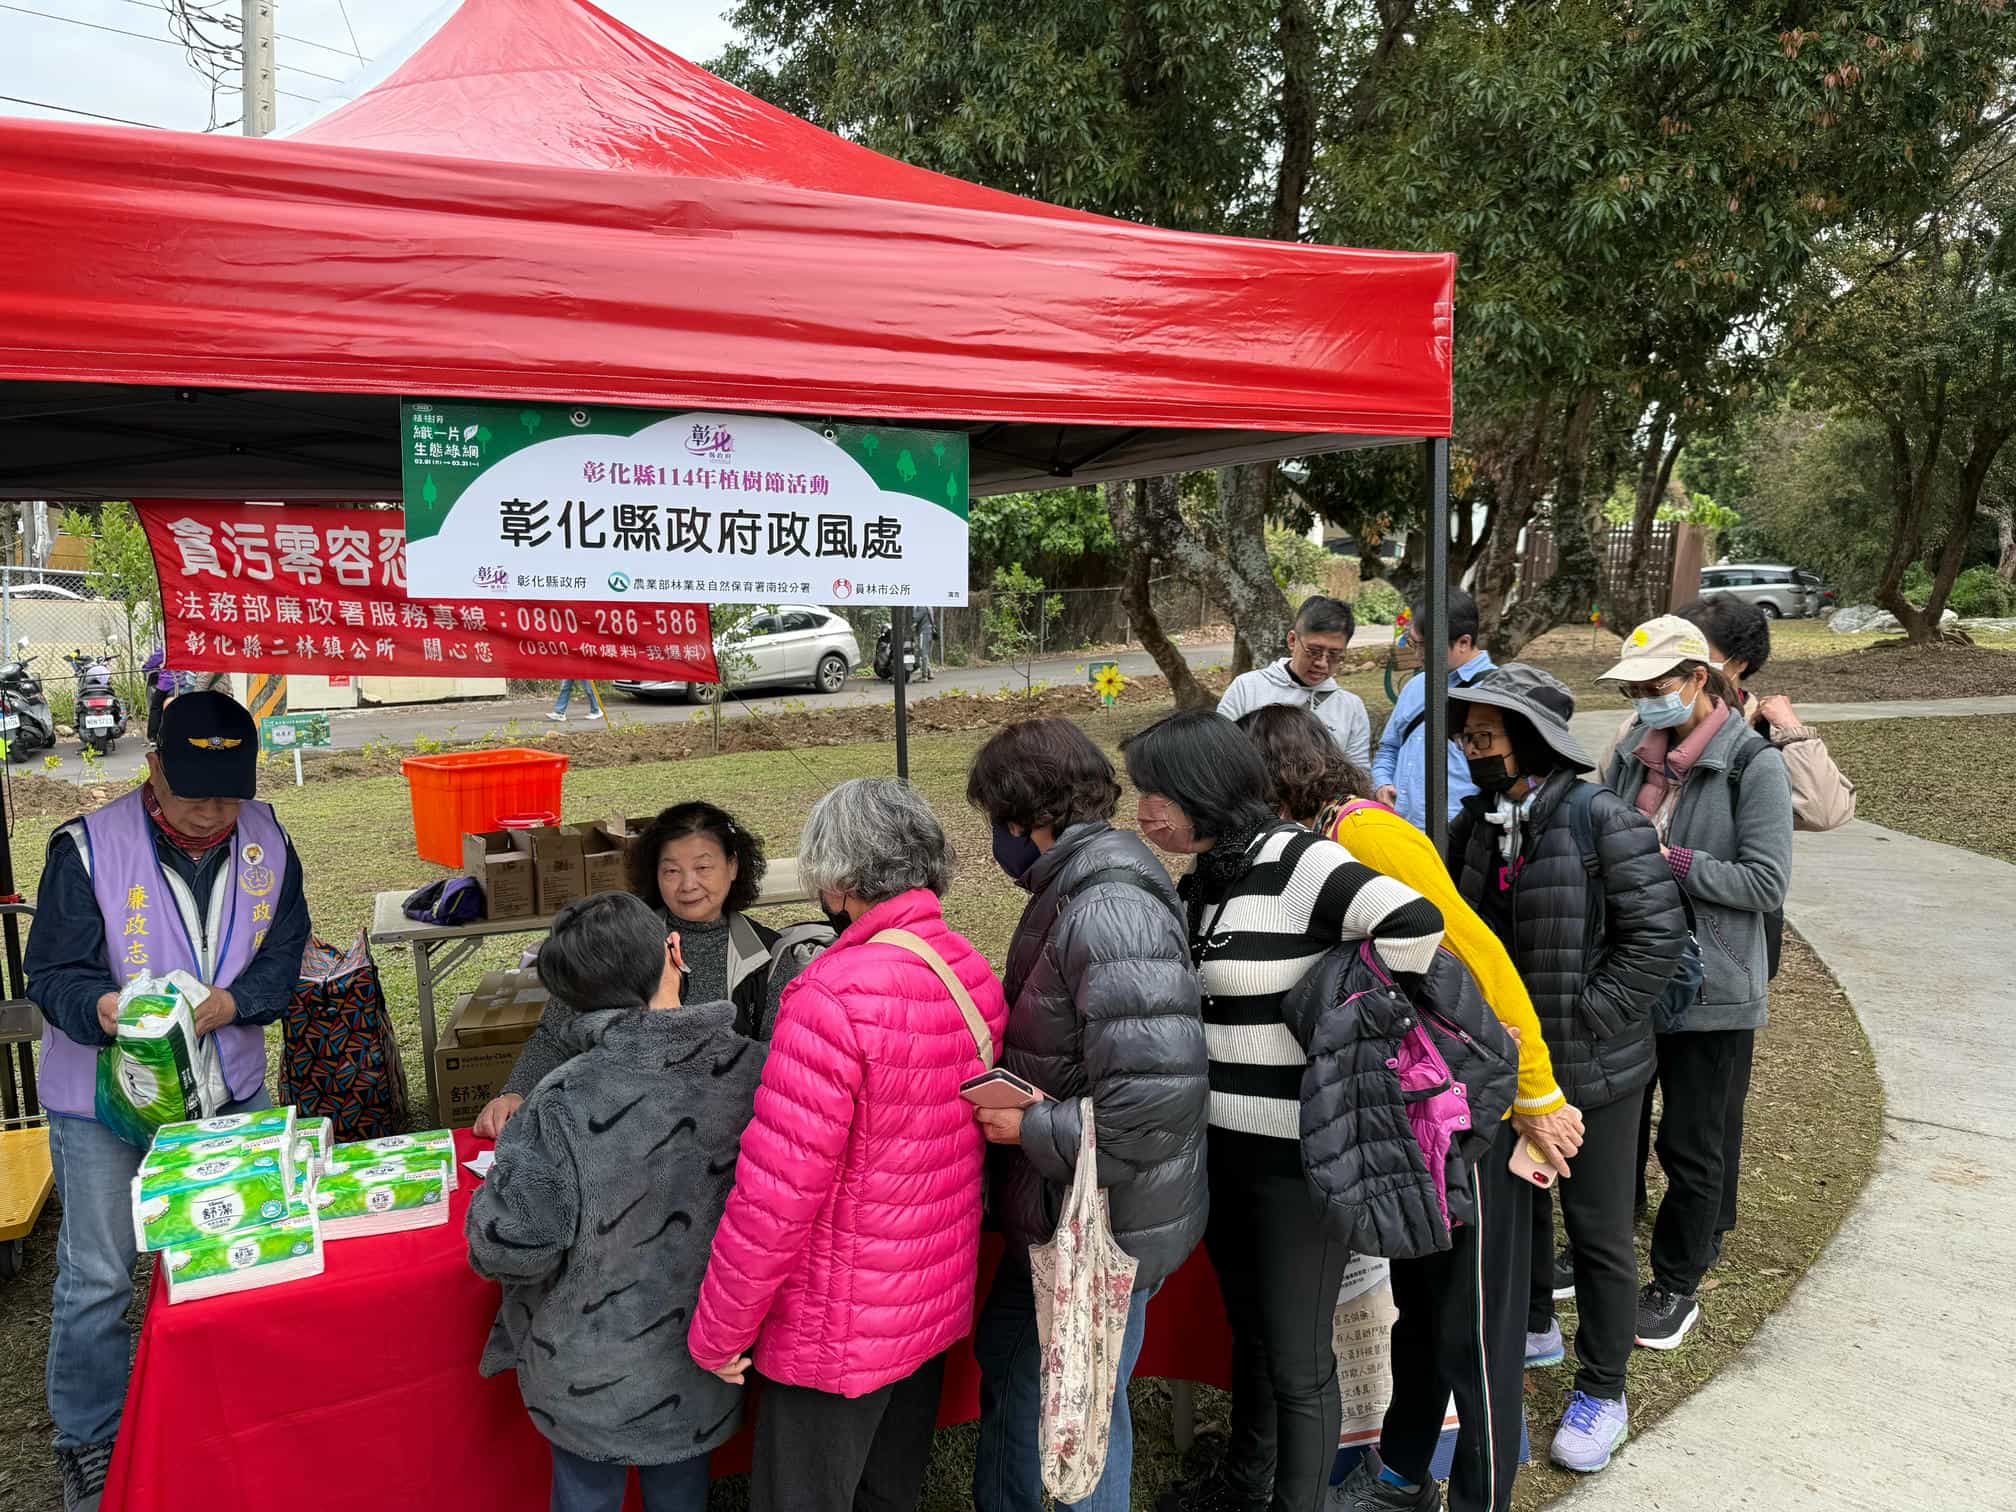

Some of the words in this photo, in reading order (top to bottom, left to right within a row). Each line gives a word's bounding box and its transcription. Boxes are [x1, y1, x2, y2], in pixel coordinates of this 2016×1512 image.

[413, 425, 460, 442] 織一片
[691, 423, 732, 452] 彰化
[414, 442, 479, 459] 生態綠網
[583, 460, 829, 496] 彰化縣114年植樹節活動
[499, 498, 903, 560] 彰化縣政府政風處
[517, 574, 588, 590] 彰化縣政府
[633, 578, 811, 595] 農業部林業及自然保育署南投分署
[855, 583, 912, 597] 員林市公所
[185, 630, 396, 661] 彰化縣二林鎮公所
[424, 637, 494, 664] 關心您
[518, 640, 707, 662] (0800-你爆料-我爆料)
[123, 884, 150, 979] 廉政志
